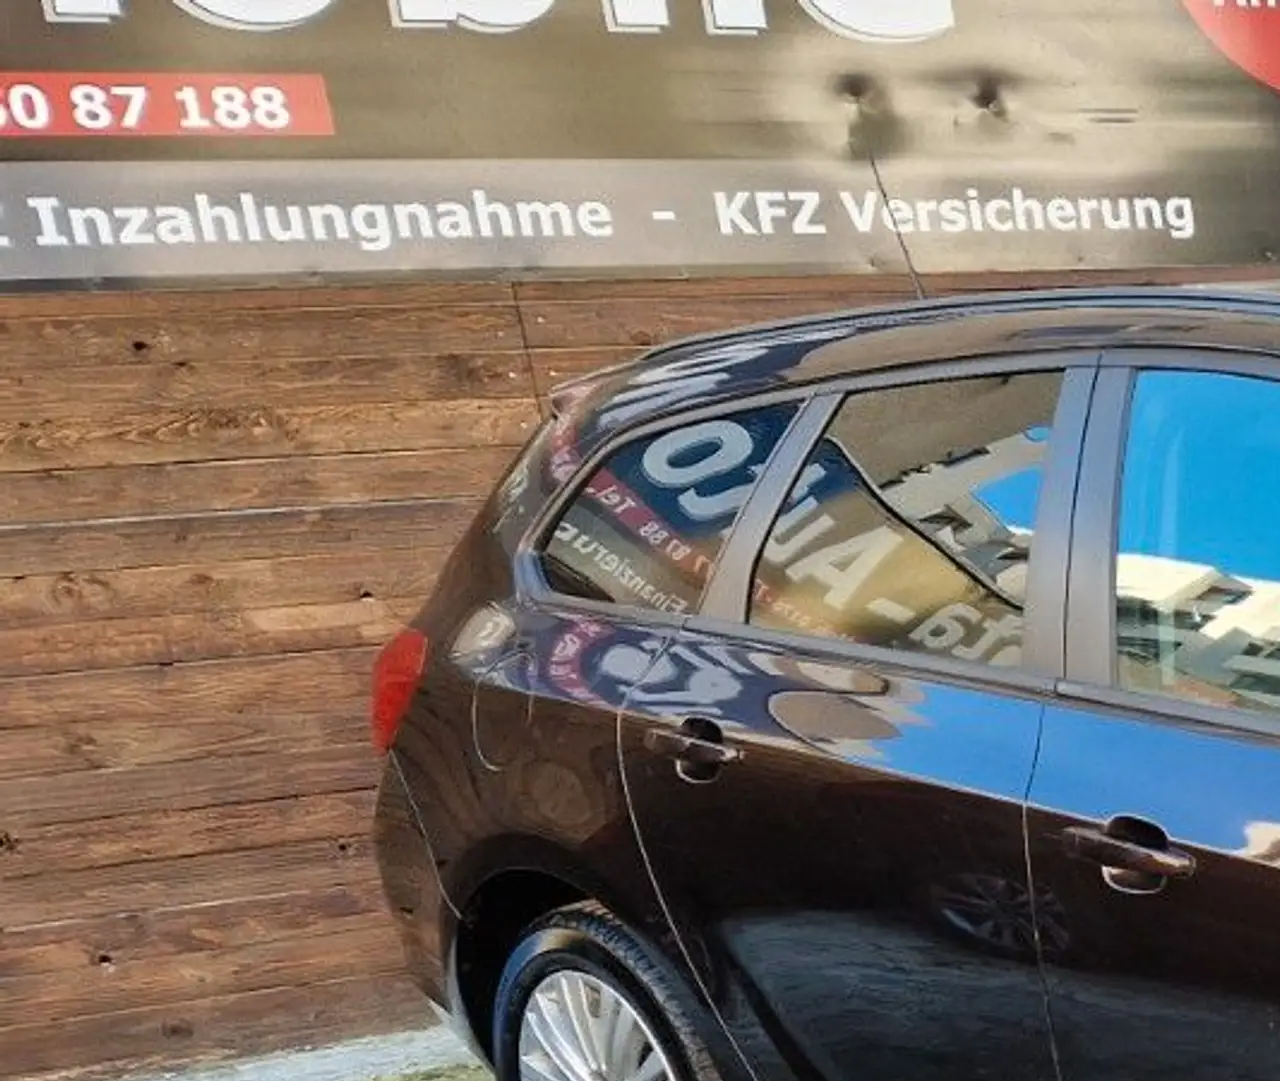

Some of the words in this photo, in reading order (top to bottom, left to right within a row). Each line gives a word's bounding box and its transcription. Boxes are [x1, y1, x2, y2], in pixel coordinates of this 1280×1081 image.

[0, 84, 51, 129] 0
[69, 84, 147, 129] 87
[174, 86, 290, 129] 188
[27, 190, 613, 251] Inzahlungnahme
[714, 190, 826, 236] KFZ
[840, 190, 1195, 240] Versicherung
